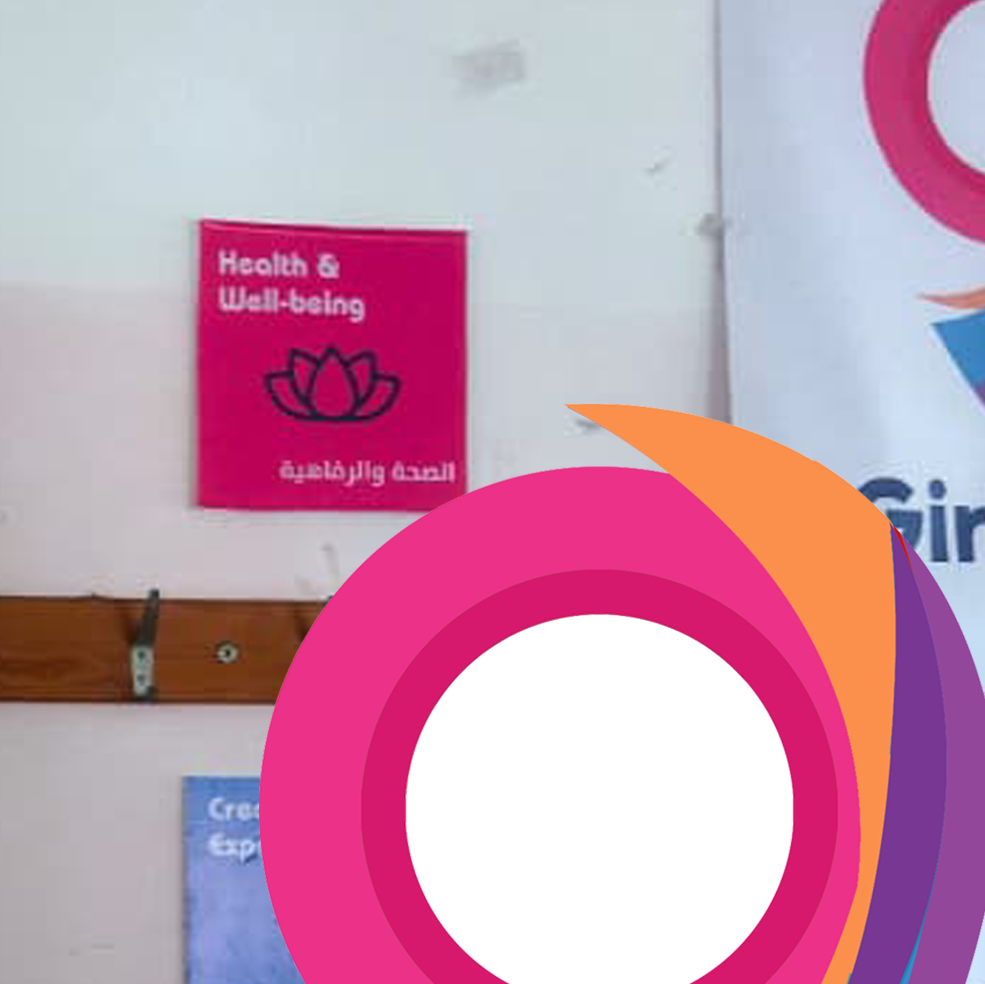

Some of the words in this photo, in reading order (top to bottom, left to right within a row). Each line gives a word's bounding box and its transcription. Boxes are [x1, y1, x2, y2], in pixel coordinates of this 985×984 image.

[218, 249, 308, 276] Health
[317, 253, 340, 279] &
[219, 286, 365, 324] Well-being
[279, 460, 384, 487] والرفاهية
[391, 460, 455, 482] الصحة
[208, 832, 262, 862] Exp
